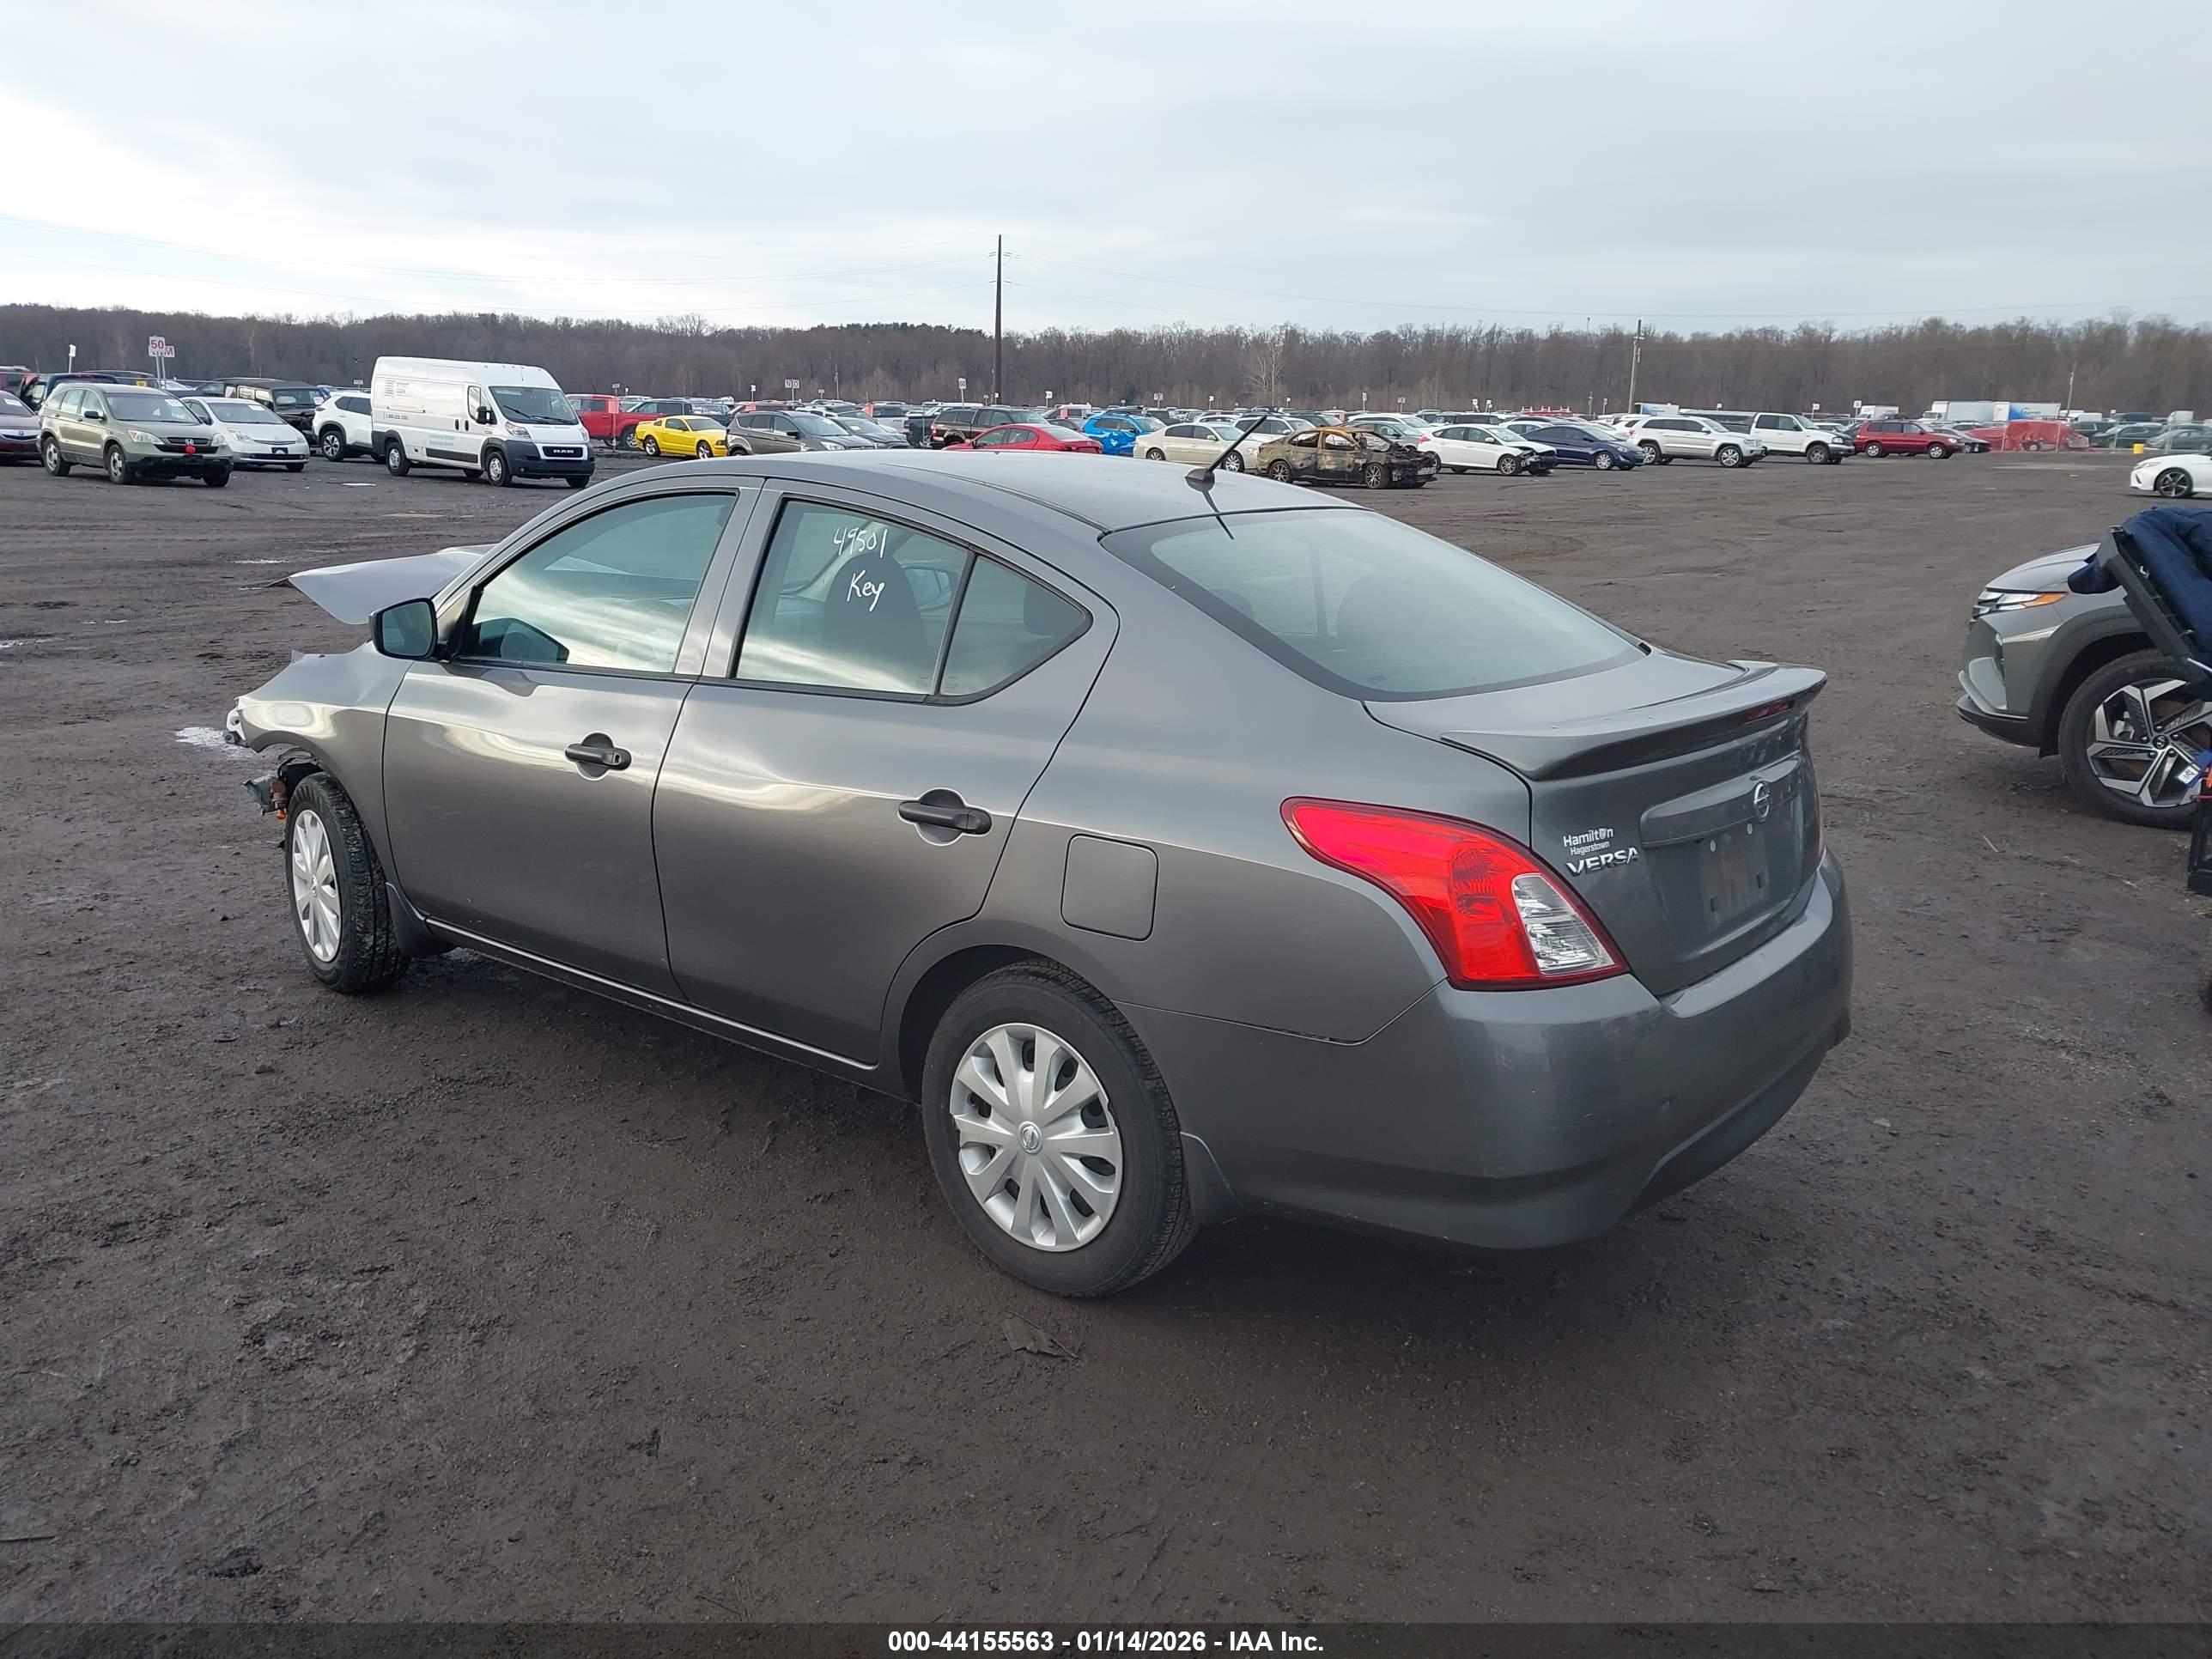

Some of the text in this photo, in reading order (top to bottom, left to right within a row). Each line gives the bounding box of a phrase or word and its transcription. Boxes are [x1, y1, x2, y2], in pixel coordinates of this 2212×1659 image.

[150, 339, 164, 349] 50
[833, 527, 887, 558] 49501
[847, 569, 884, 611] Key
[1565, 847, 1638, 874] VERSA
[1570, 841, 1611, 856] Hagerstown
